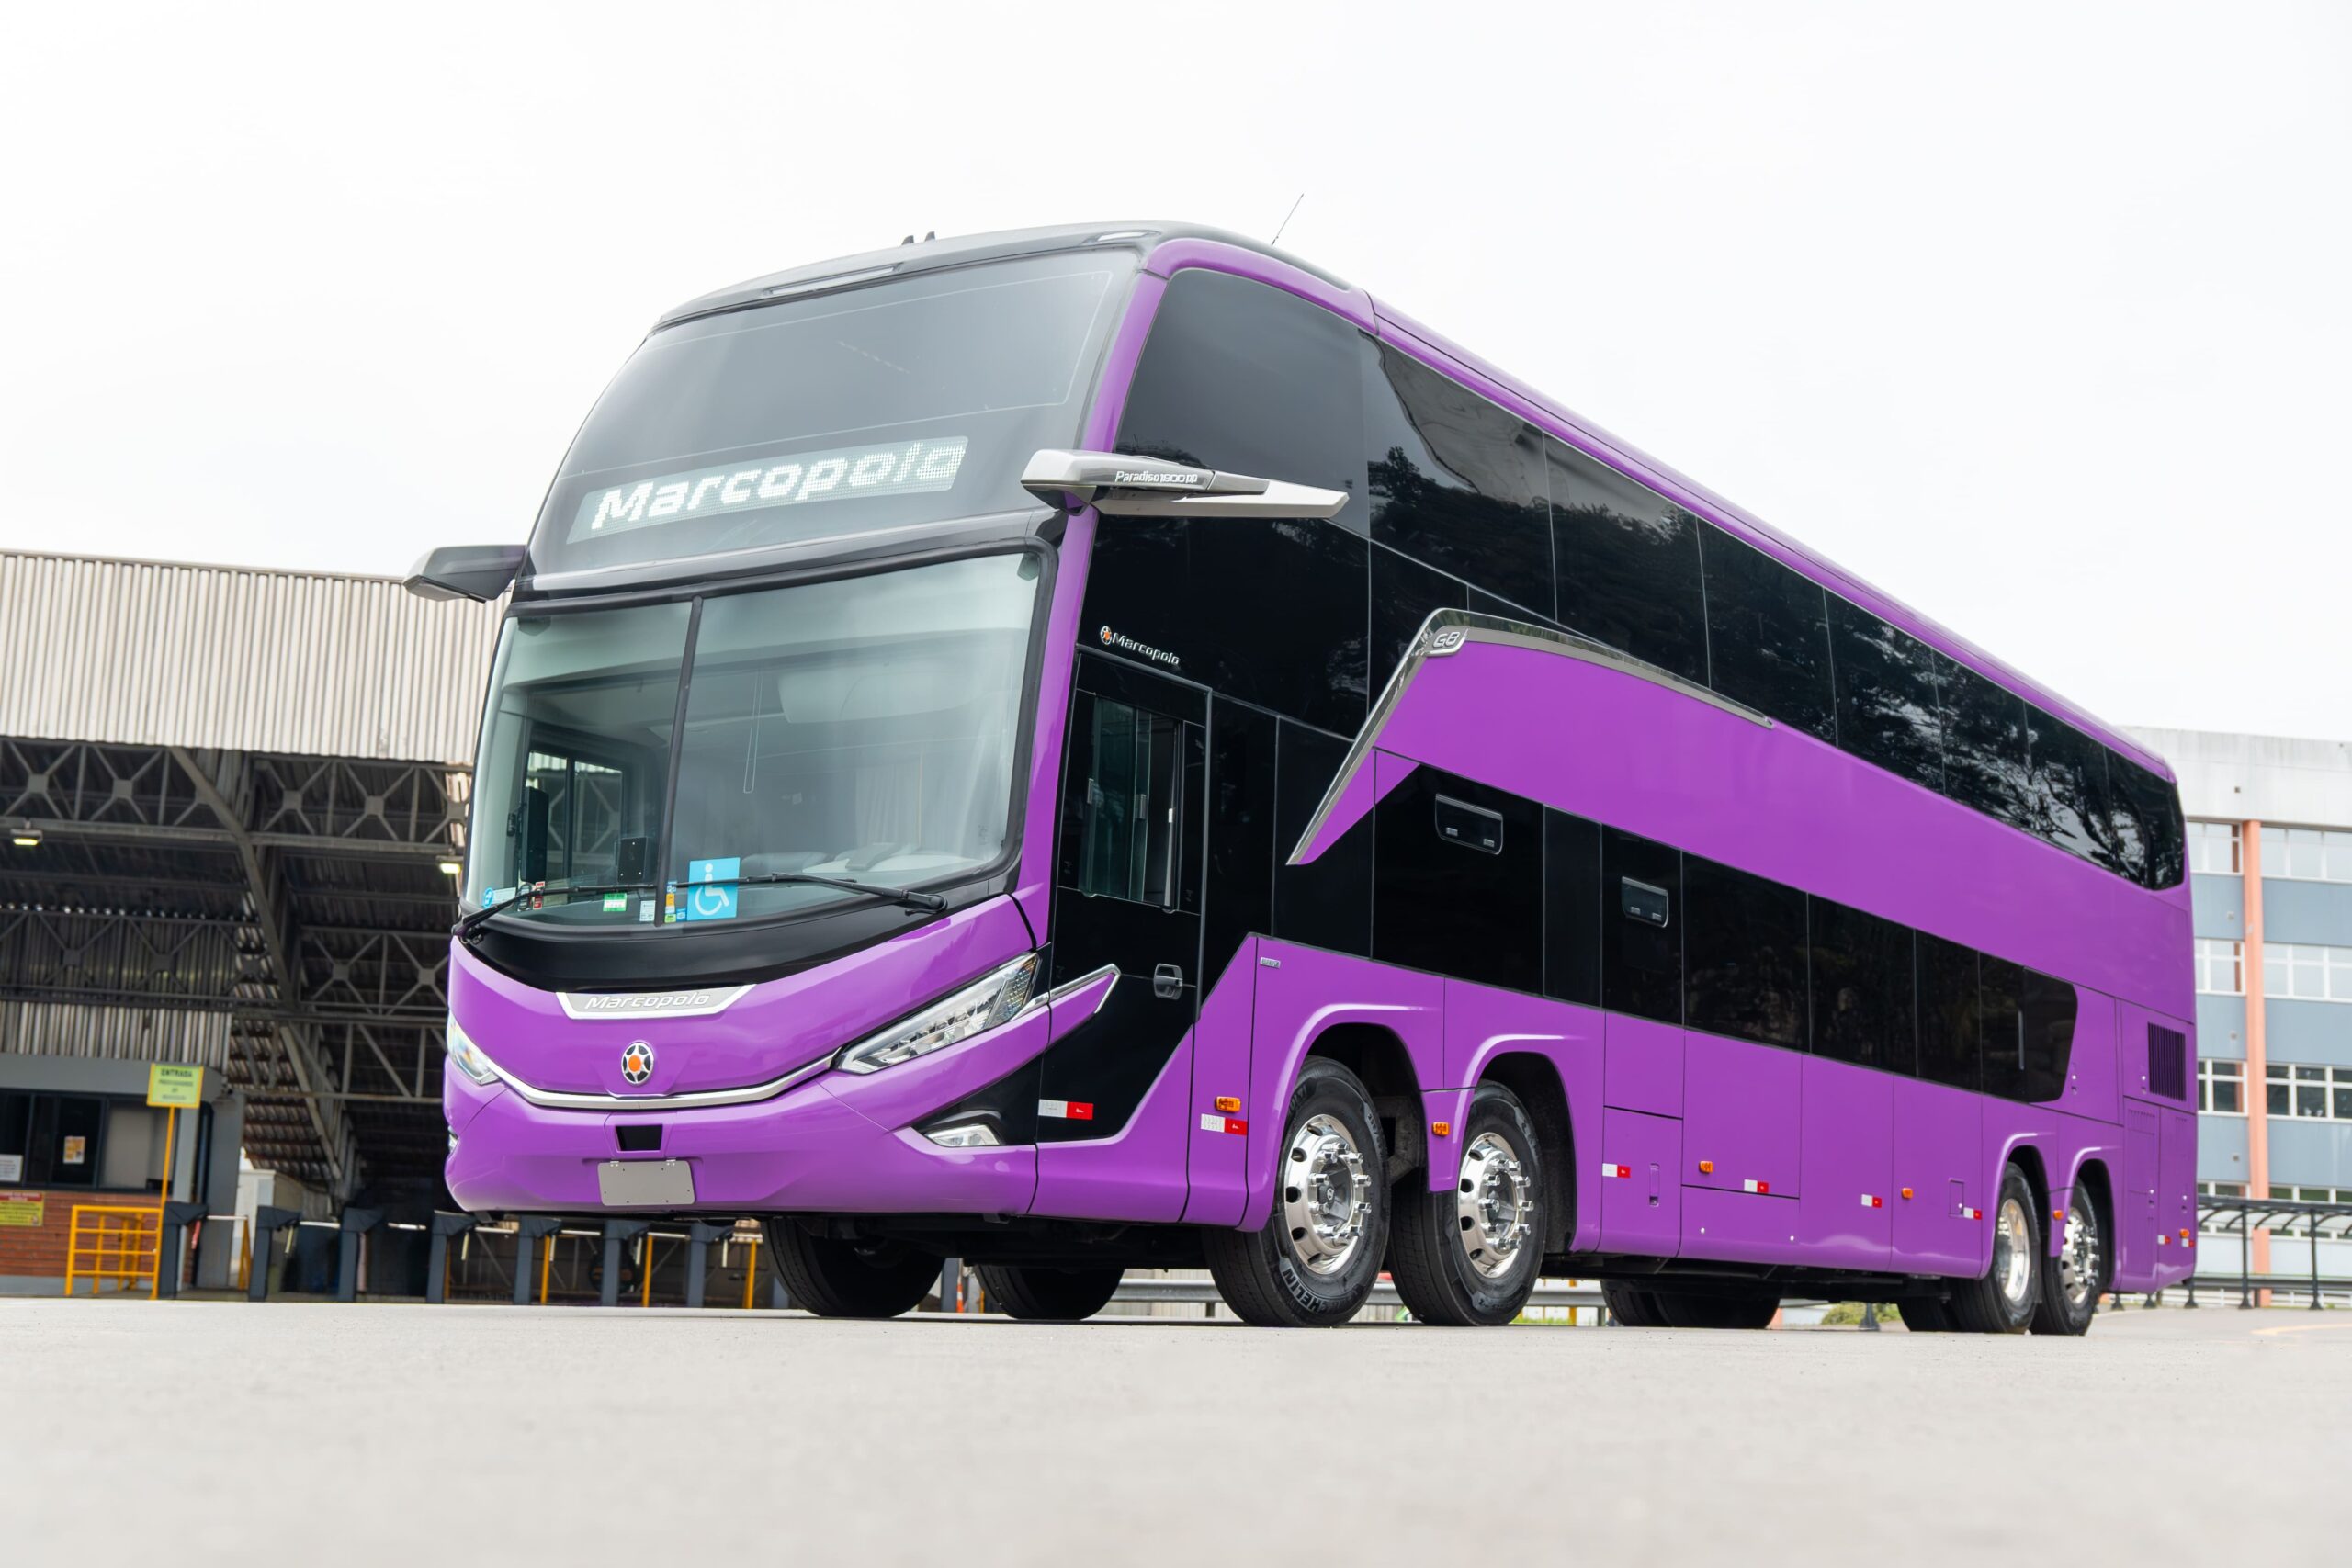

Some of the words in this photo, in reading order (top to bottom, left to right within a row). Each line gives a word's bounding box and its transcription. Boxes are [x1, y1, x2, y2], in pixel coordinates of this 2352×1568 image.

[1114, 470, 1159, 483] Paradiso
[591, 442, 966, 530] Marcopolo
[1112, 632, 1180, 665] Marcopolo
[1433, 631, 1461, 648] G8
[584, 992, 709, 1010] Marcopolo
